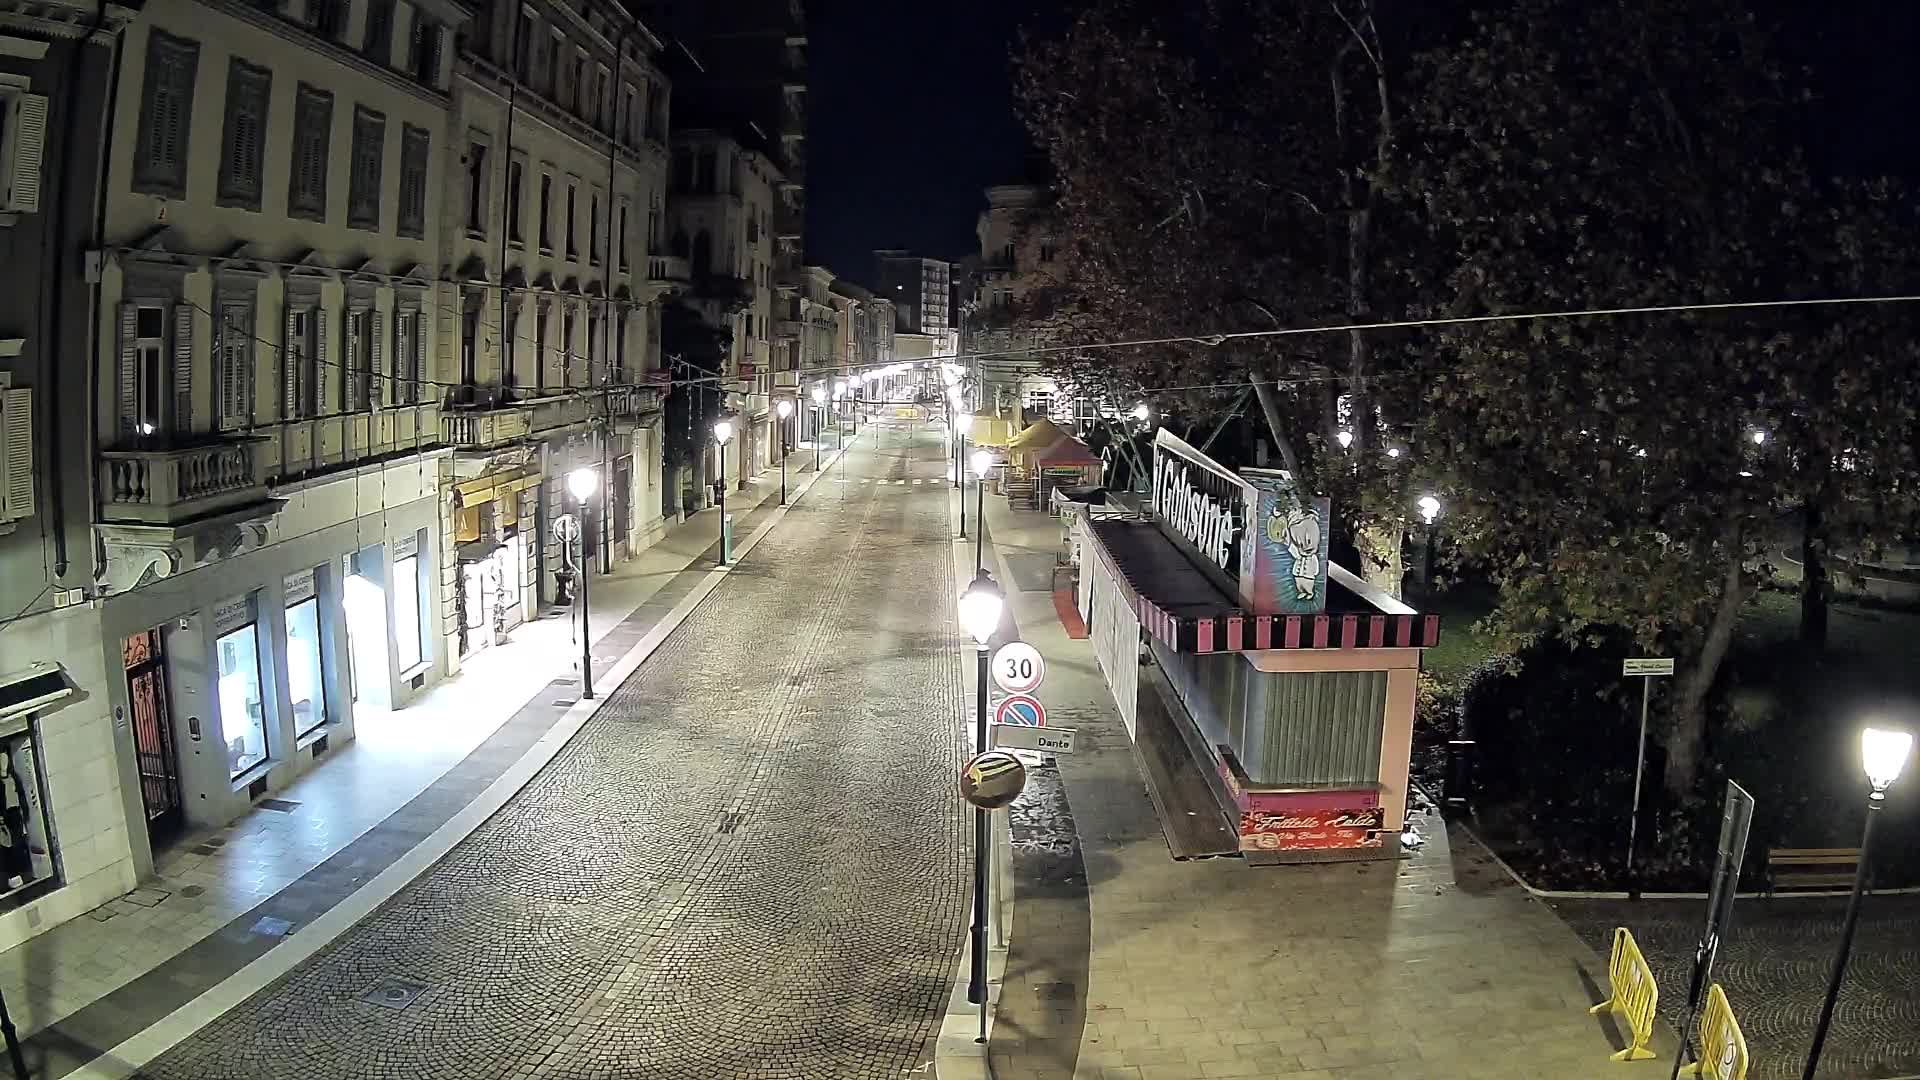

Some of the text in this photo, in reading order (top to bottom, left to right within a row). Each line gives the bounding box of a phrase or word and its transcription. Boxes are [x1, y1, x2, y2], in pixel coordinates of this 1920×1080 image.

[1162, 458, 1233, 569] Golosone
[1006, 658, 1032, 679] 30
[1038, 737, 1070, 750] Dante
[1254, 814, 1377, 830] Frittelle Calde
